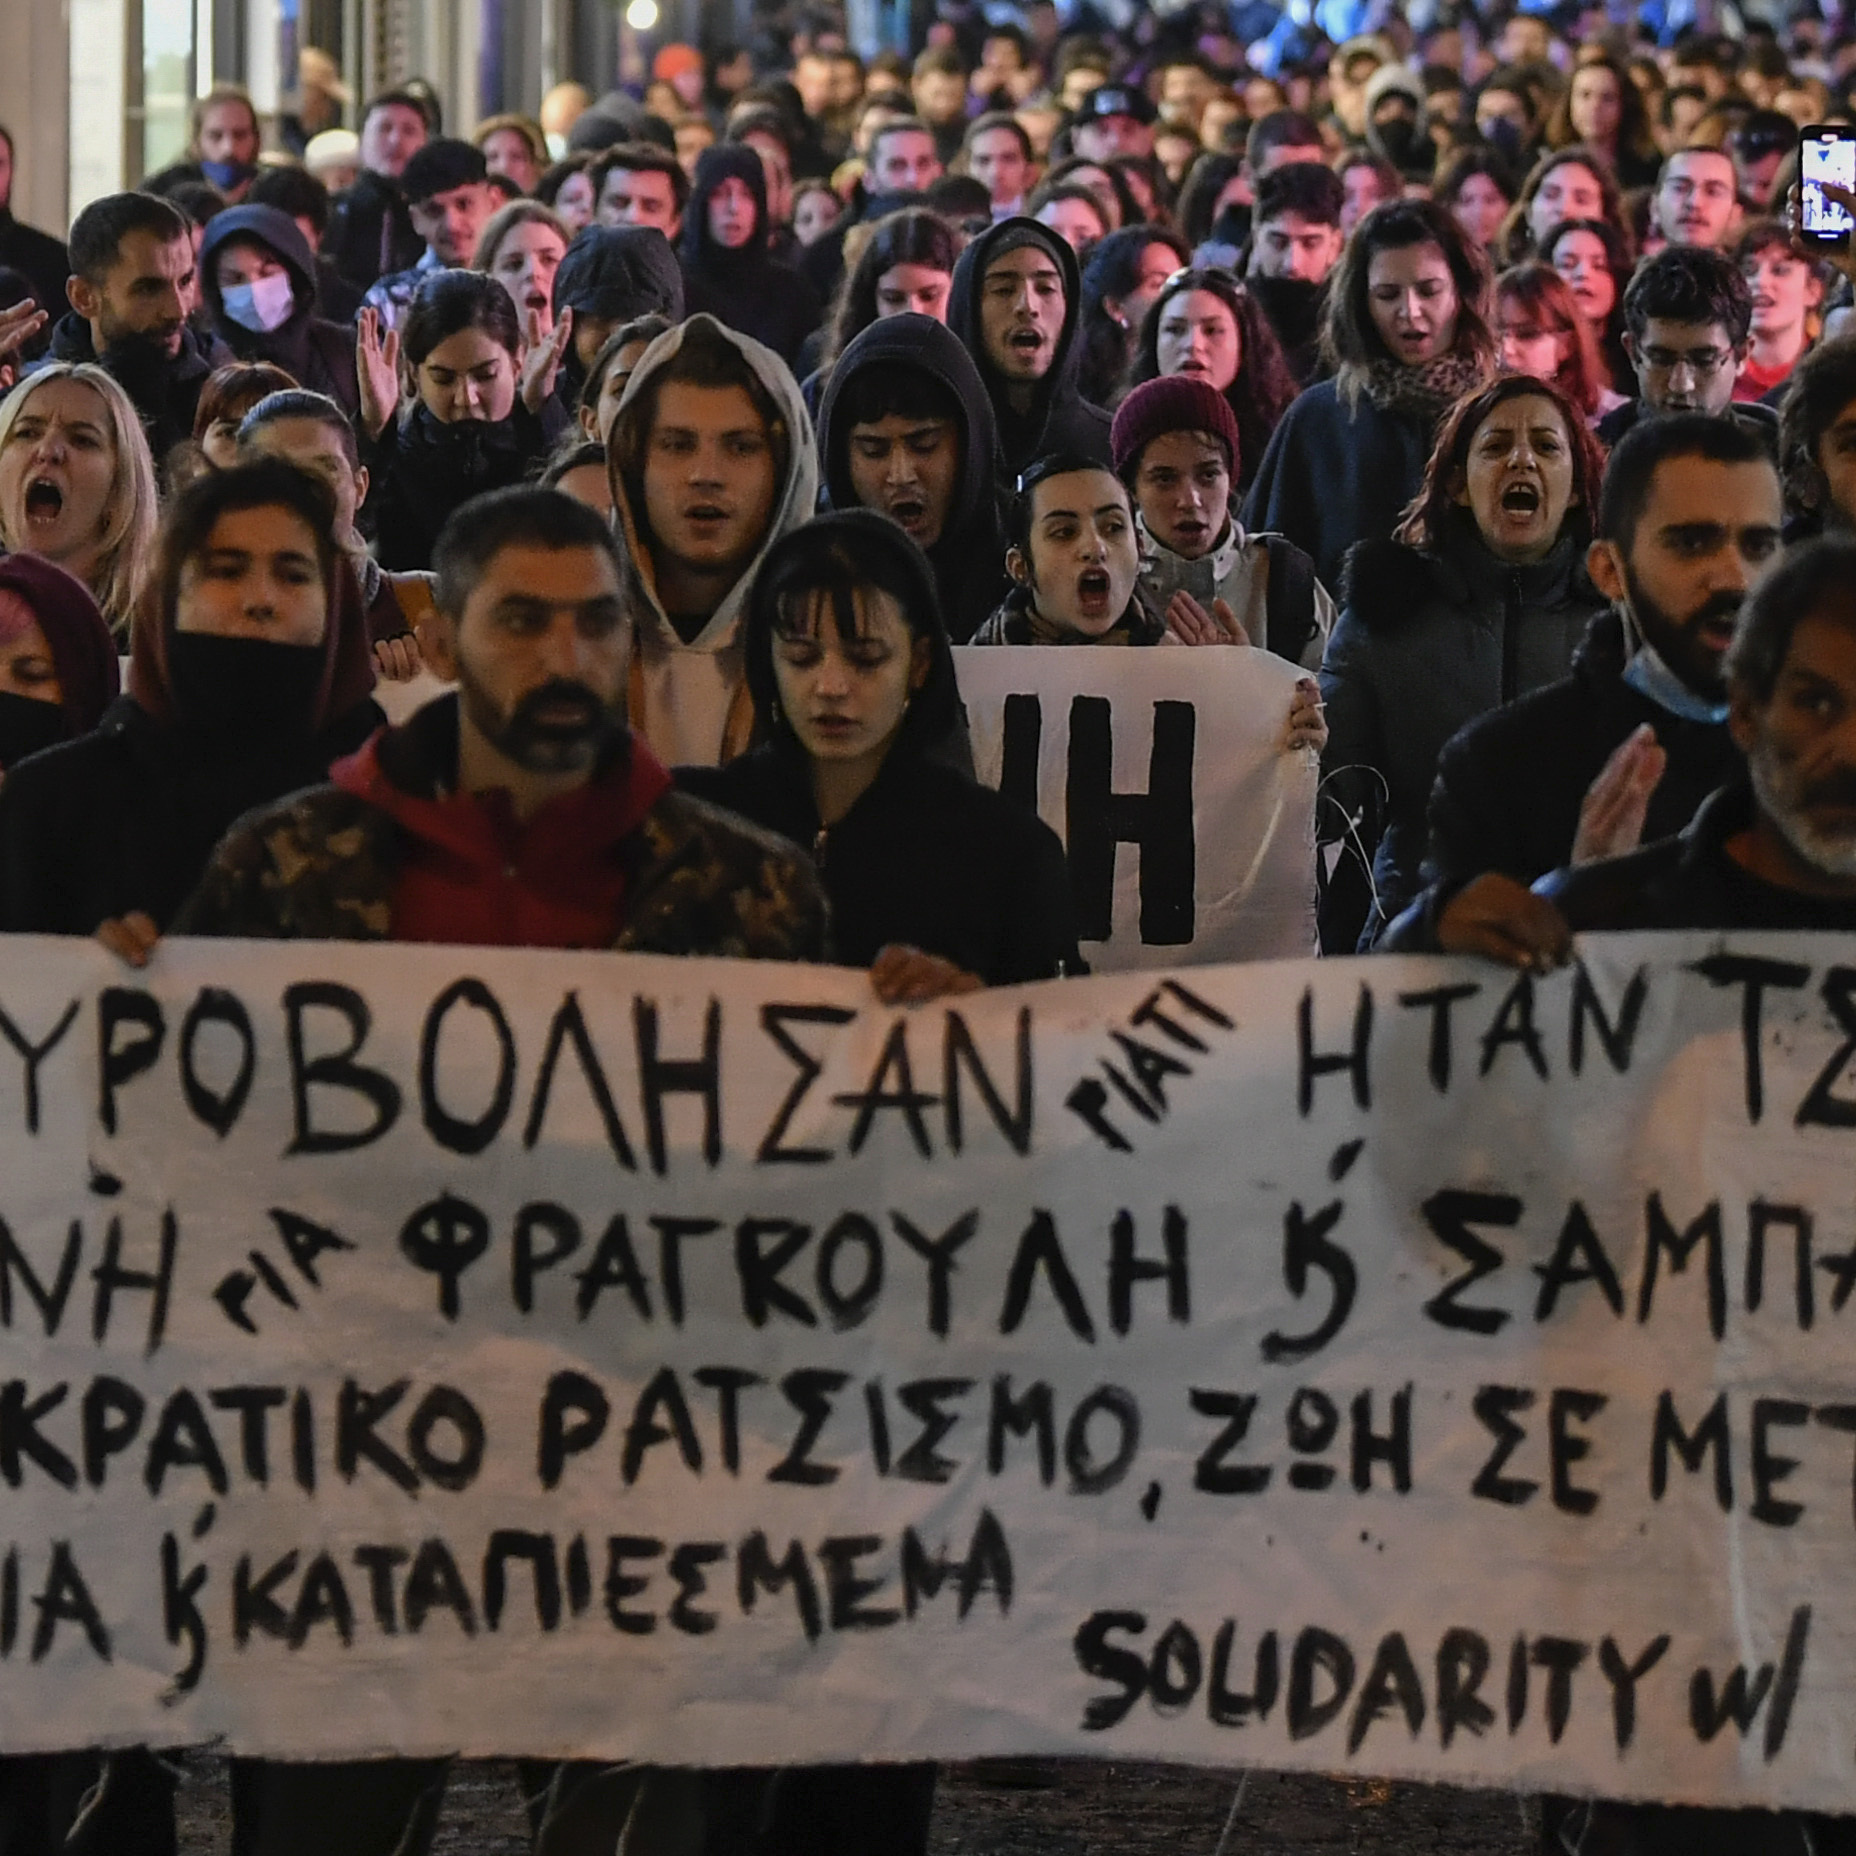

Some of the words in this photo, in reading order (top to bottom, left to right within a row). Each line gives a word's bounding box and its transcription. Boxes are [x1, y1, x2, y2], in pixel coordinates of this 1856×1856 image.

[1066, 978, 1235, 1152] ΓΙΑΤΙ
[1296, 962, 1648, 1117] ΗΤΑΝ
[212, 1206, 356, 1334] ΓΙΑ
[1471, 1384, 1608, 1515] ΣΕ
[1074, 1609, 1671, 1759] SOLIDARITY
